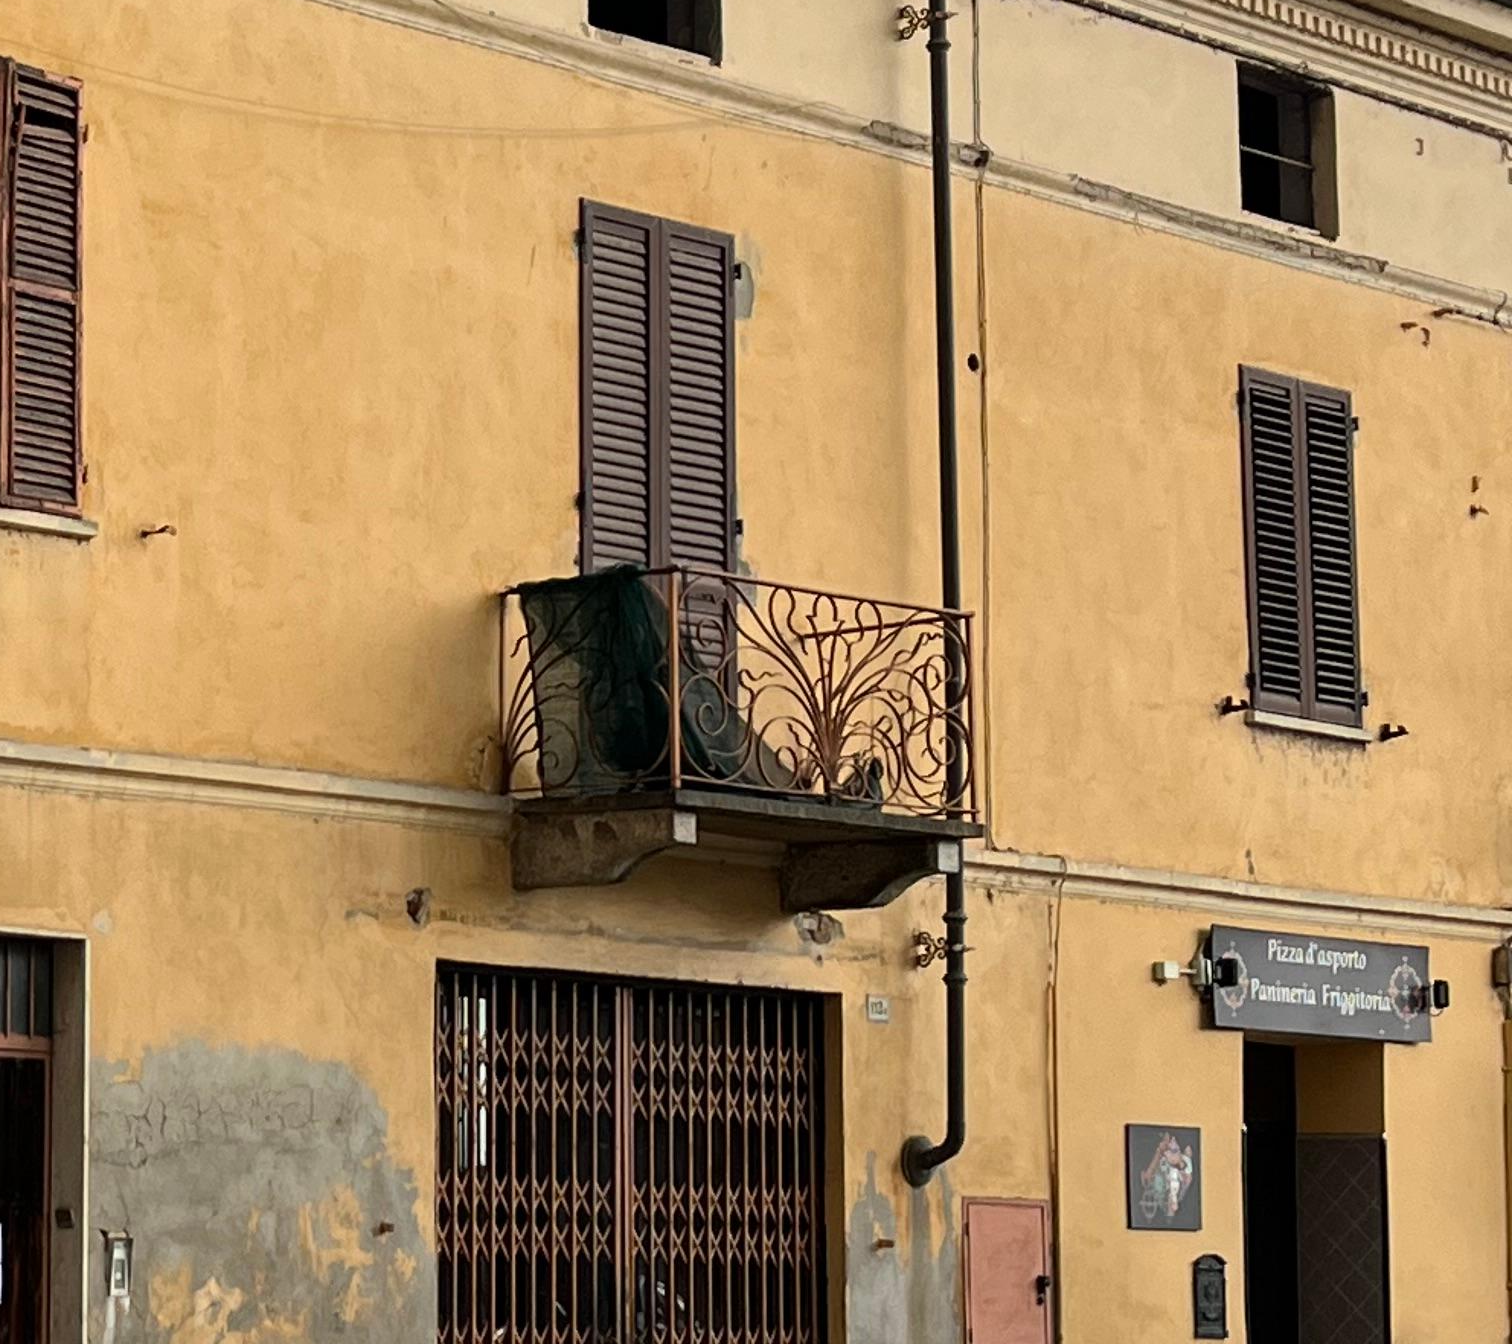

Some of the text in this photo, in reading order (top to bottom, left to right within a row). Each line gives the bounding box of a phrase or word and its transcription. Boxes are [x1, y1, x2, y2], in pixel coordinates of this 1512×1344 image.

[1267, 938, 1367, 975] Pizza d'asporto
[1250, 977, 1392, 1016] Panineria Friggitoria
